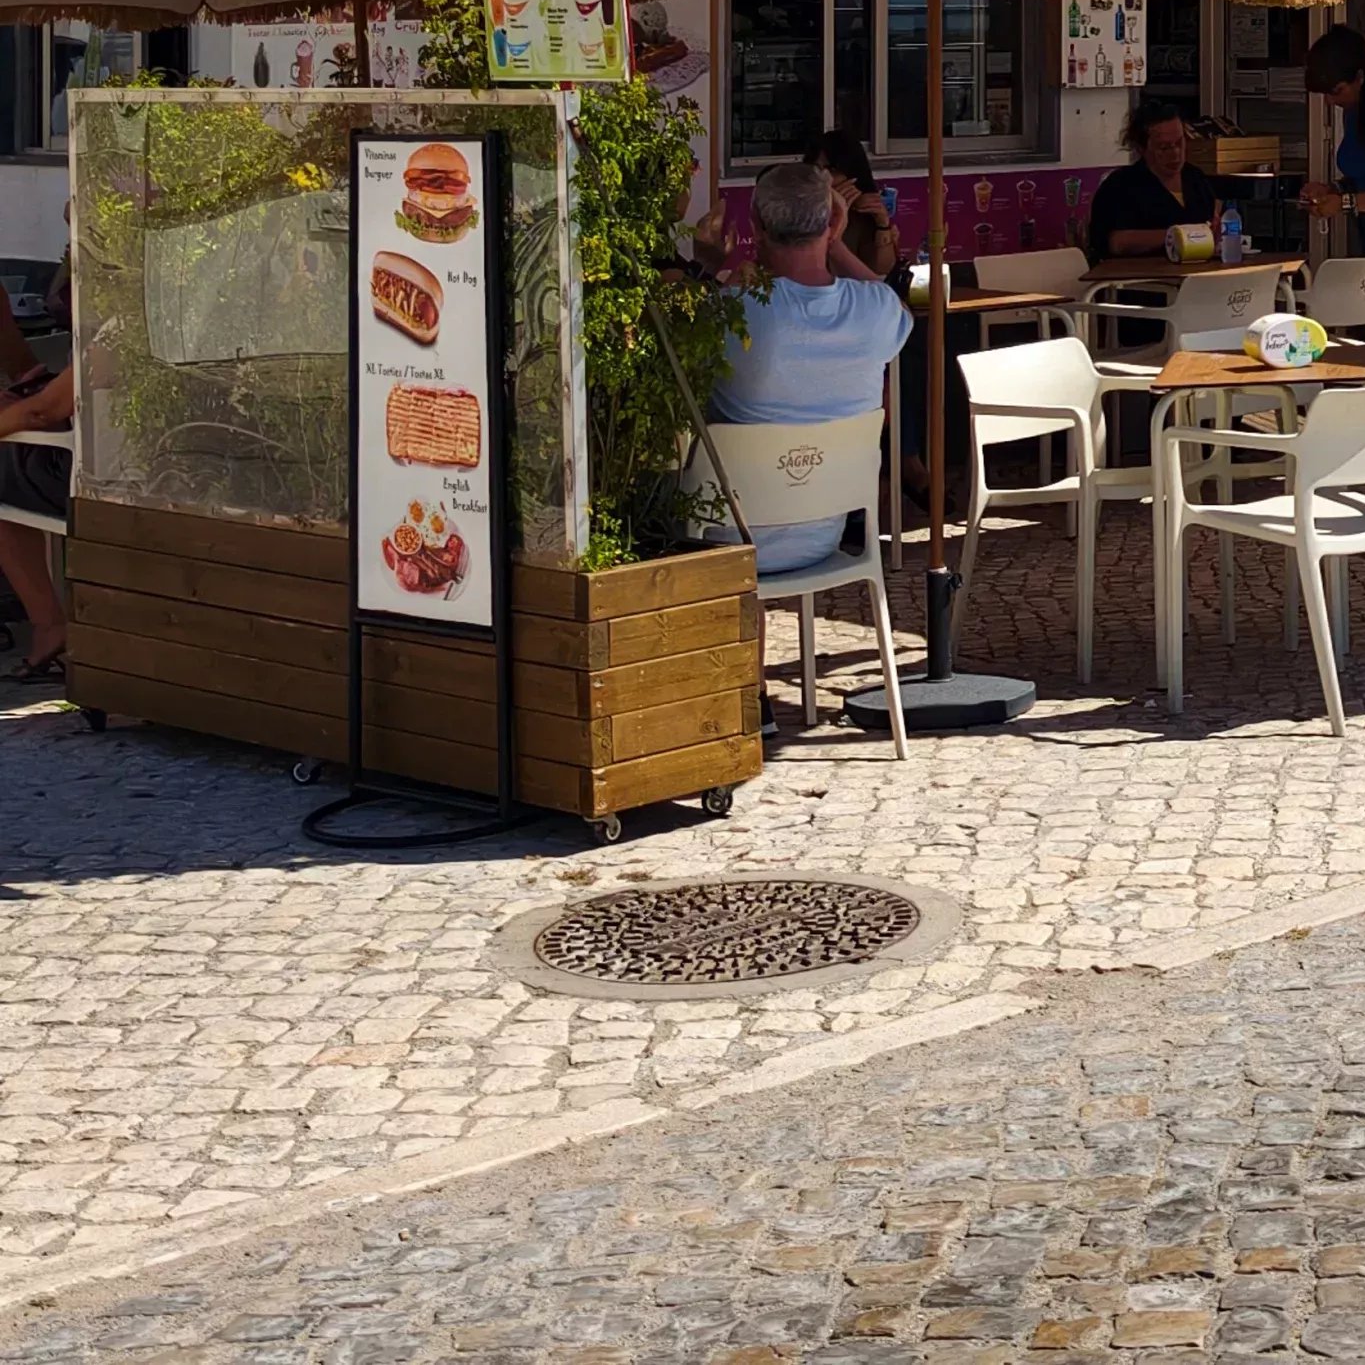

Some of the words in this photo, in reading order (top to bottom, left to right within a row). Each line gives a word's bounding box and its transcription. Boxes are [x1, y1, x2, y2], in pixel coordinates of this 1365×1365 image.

[364, 147, 397, 161] Vitaminas
[364, 166, 393, 182] Burguer
[447, 271, 460, 284] Hot
[463, 271, 477, 287] Dog
[366, 363, 377, 375] XL
[434, 368, 445, 380] XL
[776, 450, 825, 470] SAGRES
[443, 477, 470, 494] English
[453, 498, 488, 513] Breakfast
